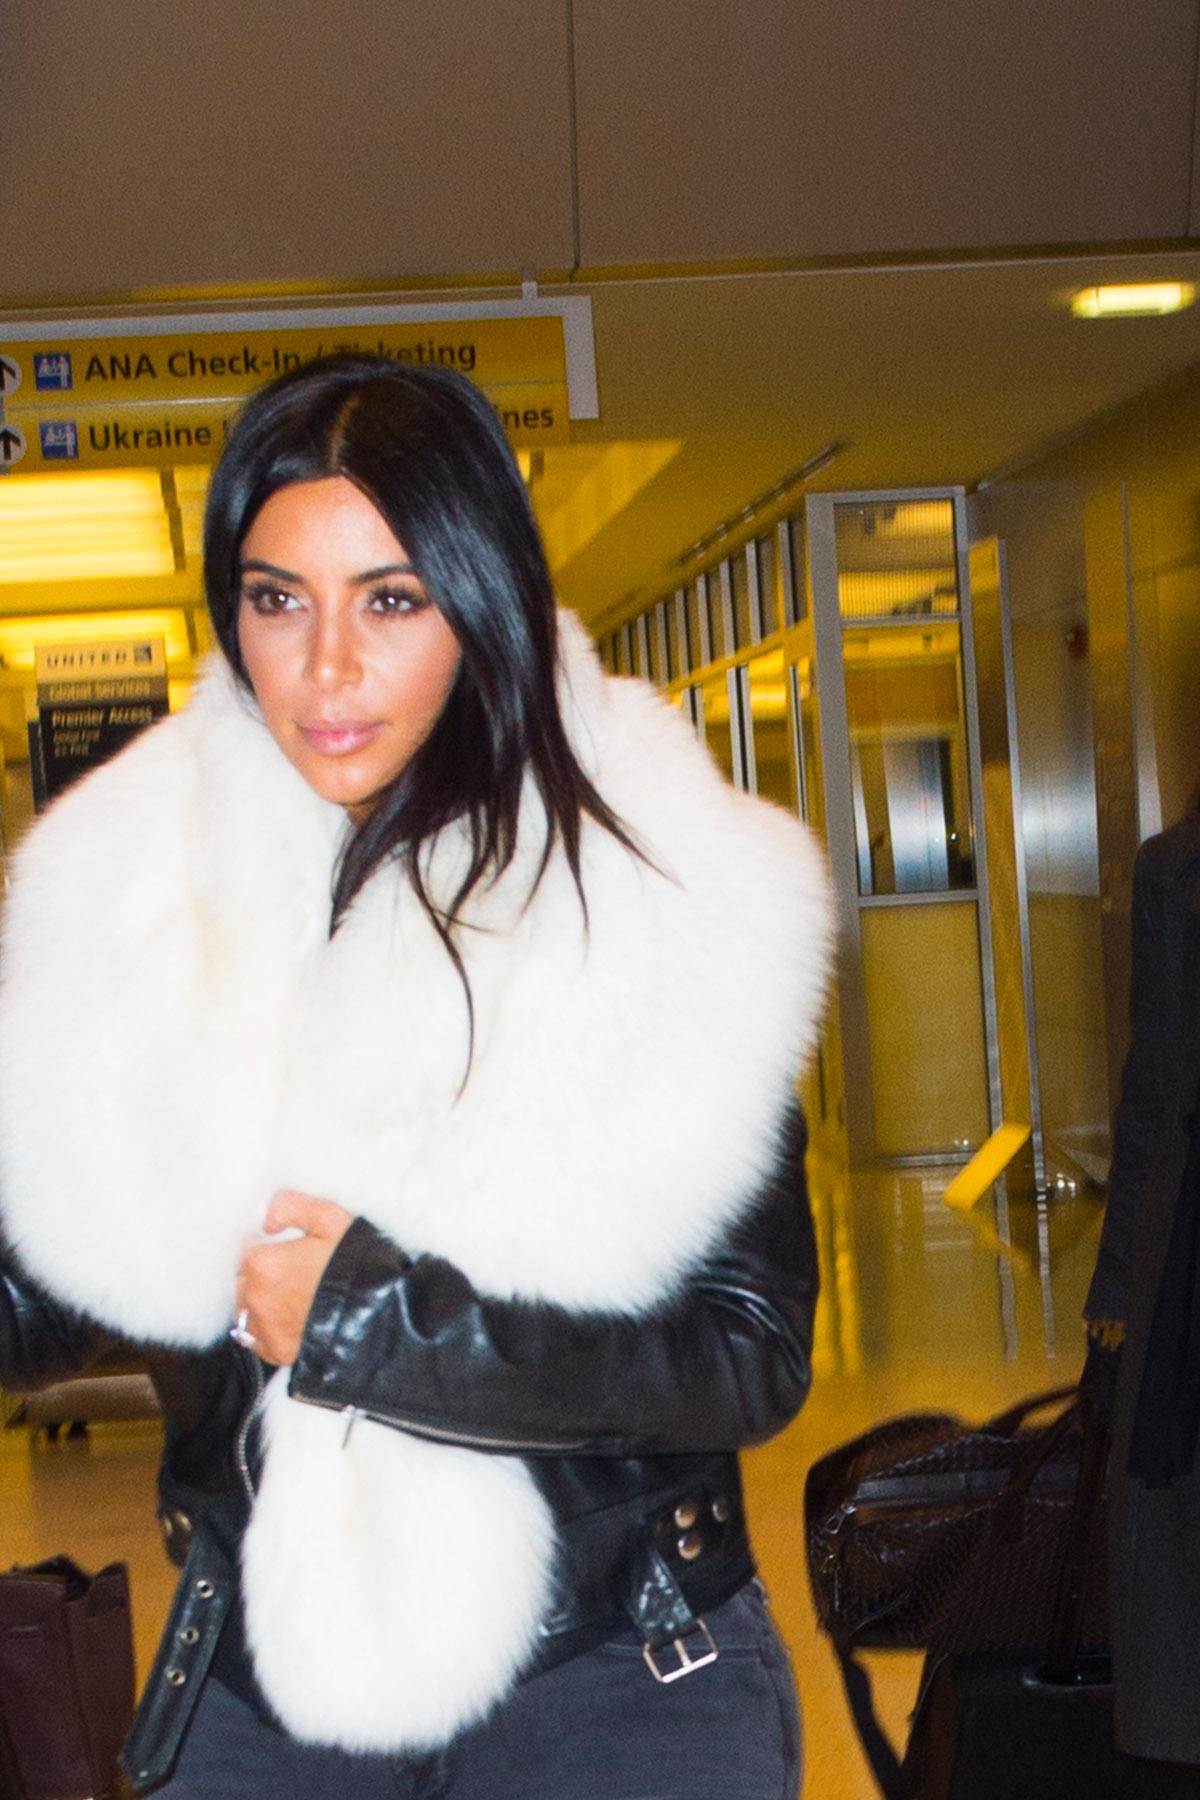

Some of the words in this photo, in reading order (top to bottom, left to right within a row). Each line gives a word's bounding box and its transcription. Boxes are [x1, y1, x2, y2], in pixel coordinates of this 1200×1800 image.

[85, 353, 157, 382] ANA
[167, 343, 300, 378] Check-In
[89, 421, 212, 451] Ukraine
[46, 650, 128, 669] UNITED
[52, 709, 104, 728] Premier
